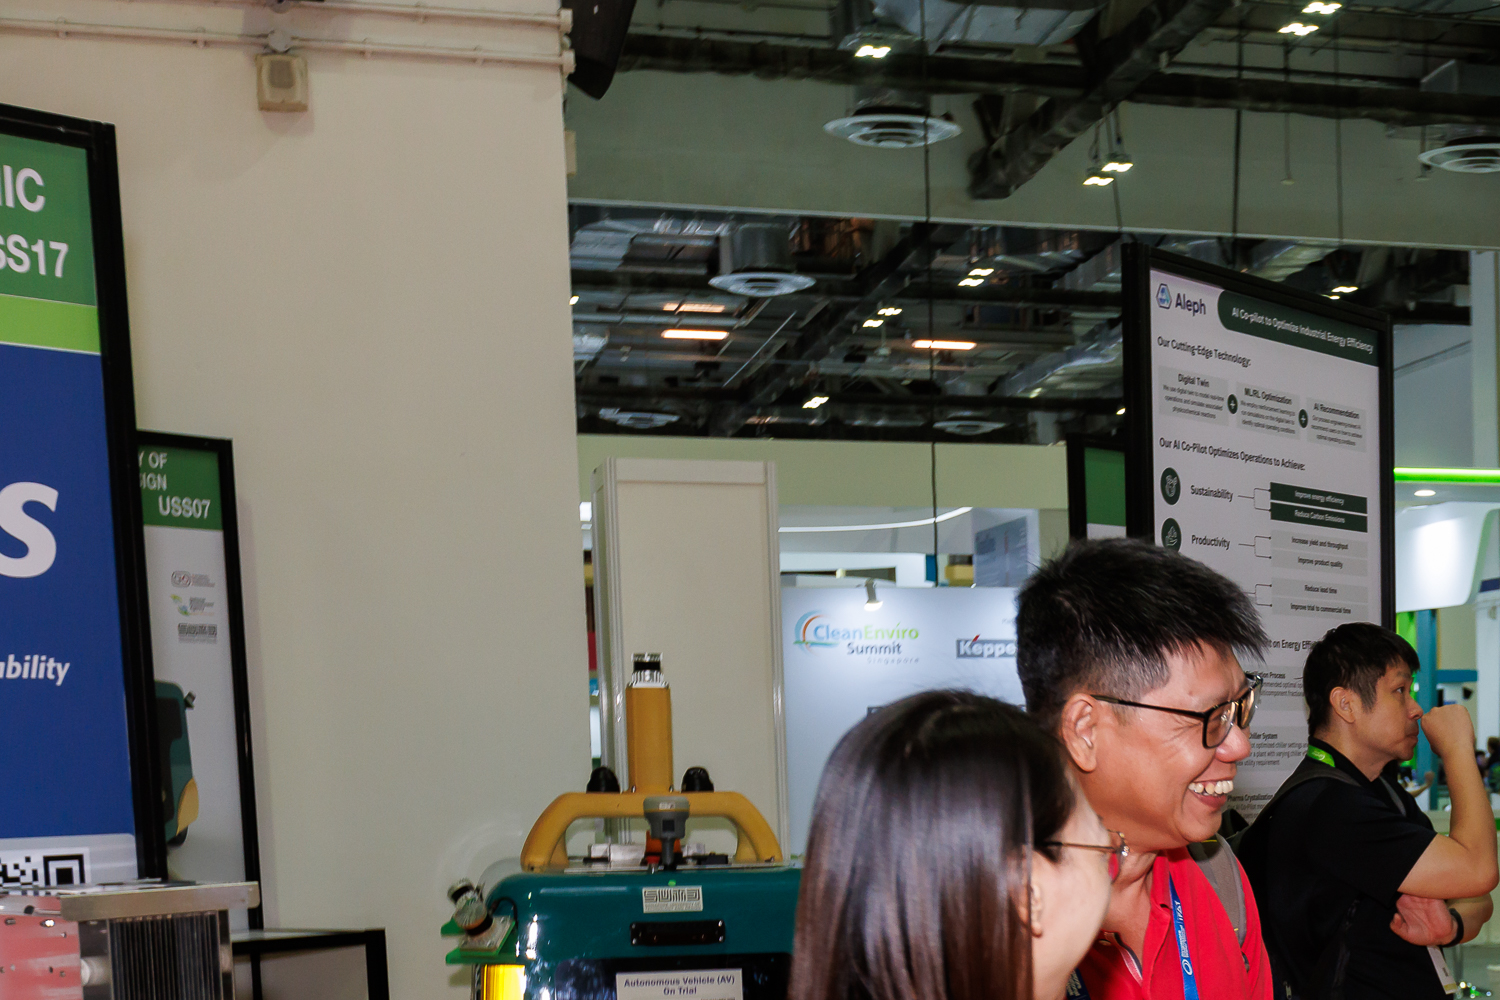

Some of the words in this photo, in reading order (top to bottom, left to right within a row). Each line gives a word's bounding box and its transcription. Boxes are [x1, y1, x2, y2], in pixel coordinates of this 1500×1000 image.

[1176, 292, 1206, 318] Aleph
[1232, 307, 1239, 317] AI
[1265, 317, 1271, 326] to
[1274, 318, 1298, 334] Optimize
[1300, 325, 1326, 340] Industrial
[1328, 332, 1345, 346] Energy
[1347, 337, 1373, 354] Efficiency
[1158, 336, 1169, 347] Our
[1171, 338, 1212, 359] Cutting-Edge
[1178, 373, 1195, 386] Digital
[1197, 378, 1209, 387] Twin
[1262, 391, 1291, 406] Optimization
[1160, 437, 1172, 448] Our
[1173, 439, 1180, 449] AI
[1182, 441, 1207, 454] Co-Pilot
[1209, 445, 1239, 461] Optimizes
[1240, 451, 1272, 467] Operations
[1274, 457, 1280, 466] to
[1191, 484, 1233, 502] Sustainability
[158, 495, 211, 519] USS07
[1192, 535, 1230, 549] Productivity
[813, 622, 920, 640] CleanEnviro
[847, 641, 903, 657] Summit
[958, 640, 1017, 658] Keppe
[1281, 639, 1301, 651] Energy
[624, 978, 680, 988] Autonomous
[682, 975, 715, 986] Vehicle
[717, 974, 735, 985] (AV)
[663, 987, 676, 996] On
[678, 986, 697, 996] Trial
